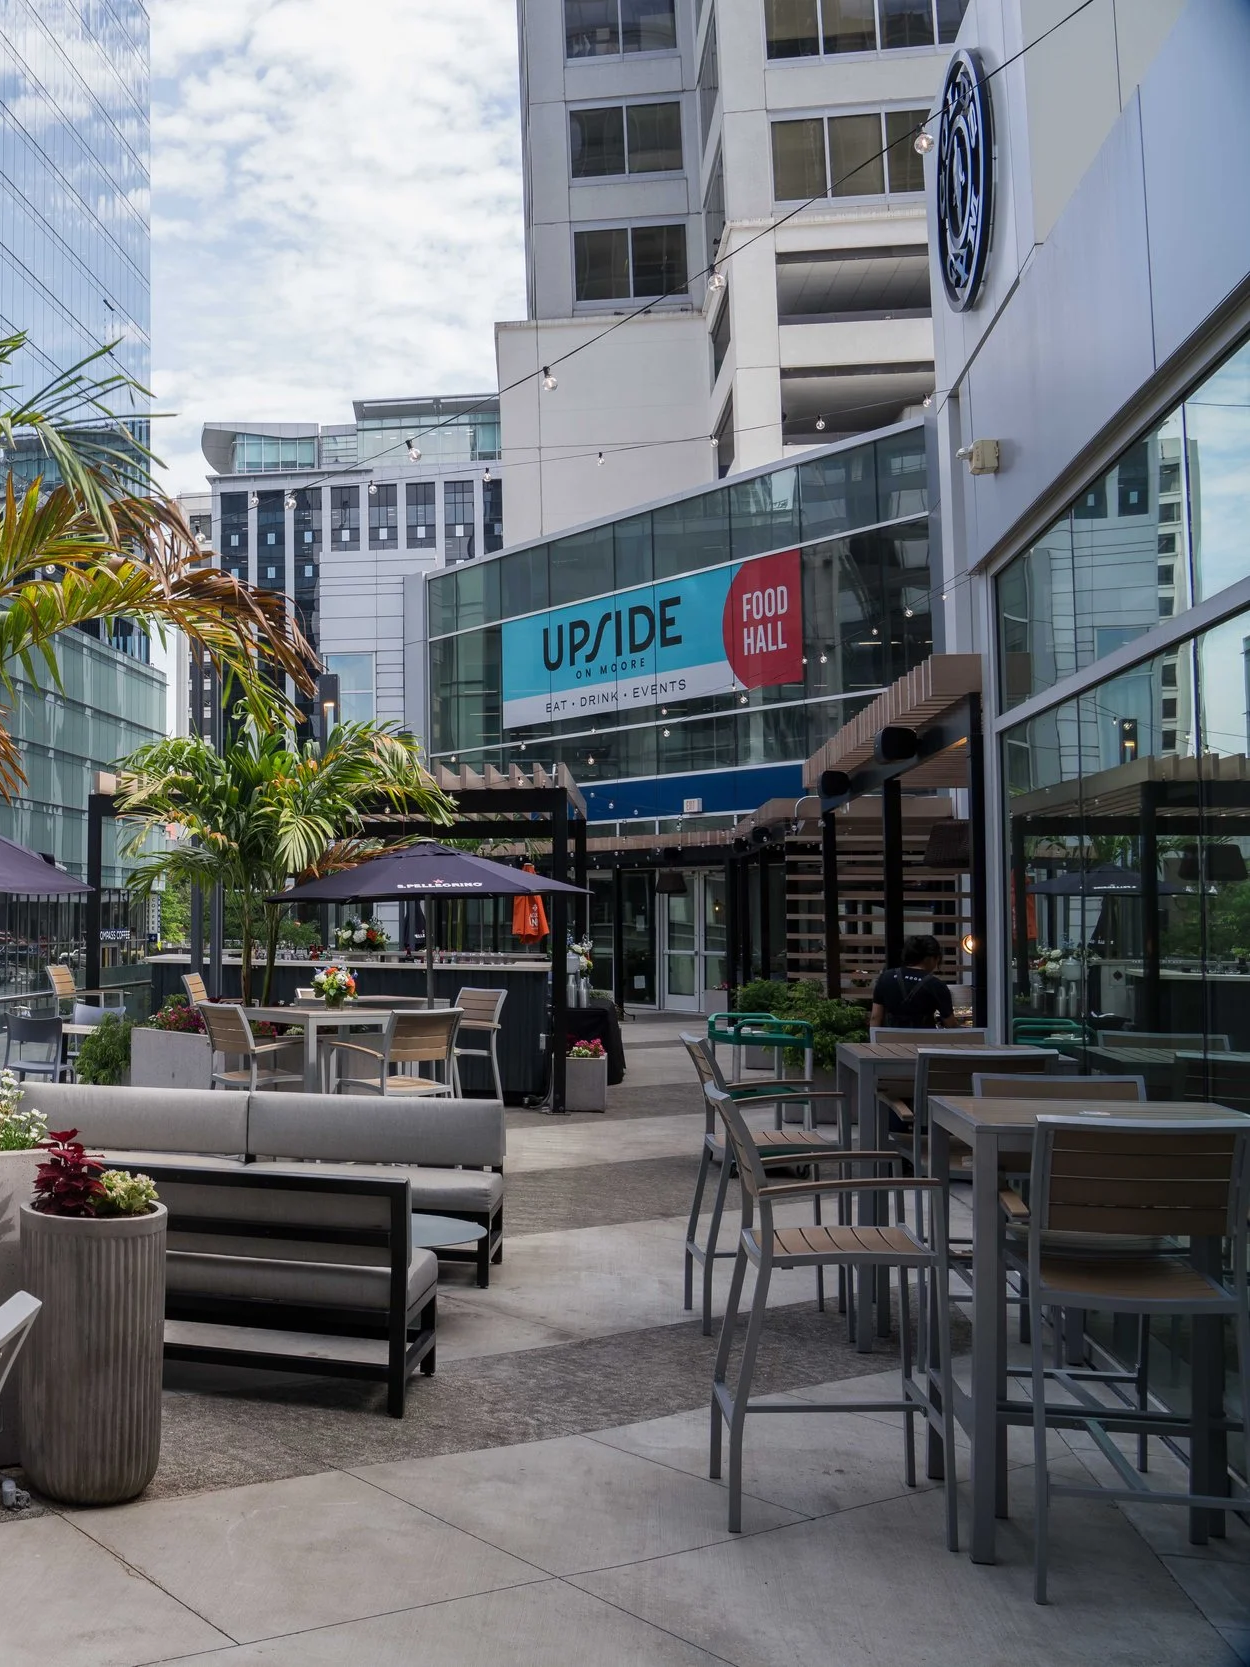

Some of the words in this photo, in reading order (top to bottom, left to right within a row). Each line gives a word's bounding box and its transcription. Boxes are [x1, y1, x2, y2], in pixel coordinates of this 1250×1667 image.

[741, 586, 788, 622] FOOD
[542, 596, 683, 672] UPSIDE
[743, 622, 788, 655] HALL
[575, 669, 592, 680] ON
[600, 657, 646, 674] MOORE
[546, 700, 568, 713] EAT
[580, 691, 618, 707] DRINK
[633, 679, 687, 698] EVENTS
[100, 930, 116, 940] OMPASS
